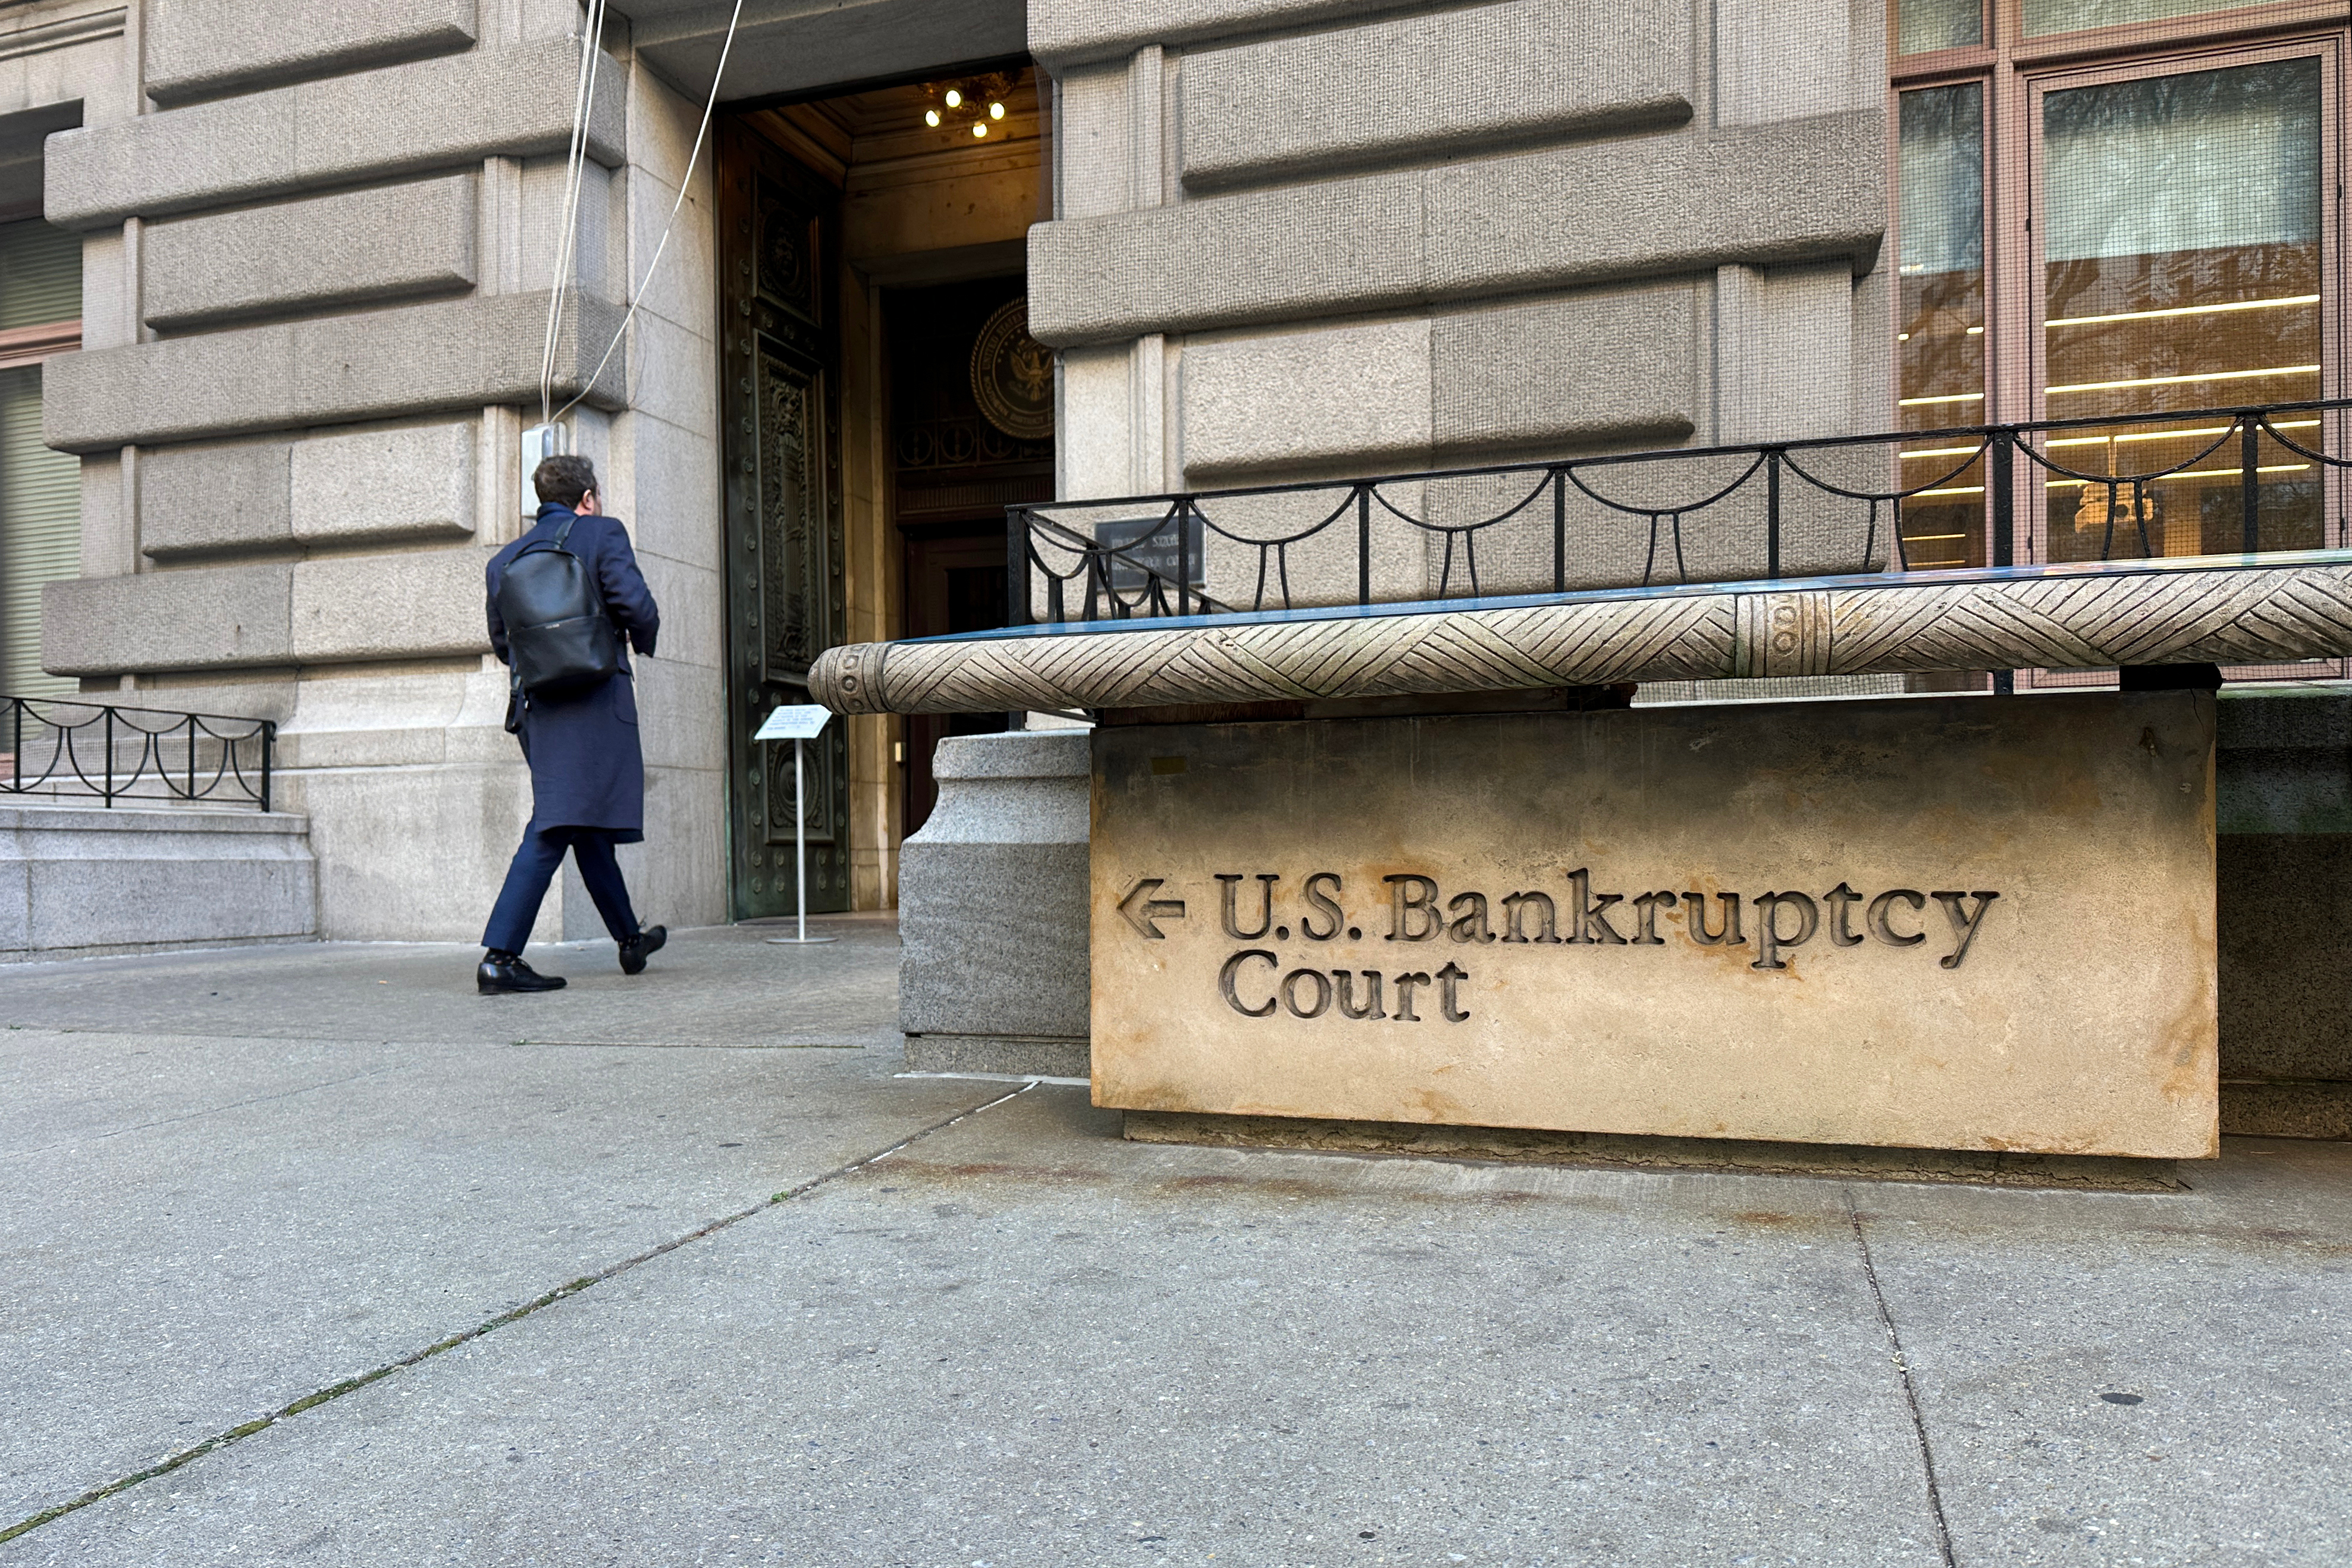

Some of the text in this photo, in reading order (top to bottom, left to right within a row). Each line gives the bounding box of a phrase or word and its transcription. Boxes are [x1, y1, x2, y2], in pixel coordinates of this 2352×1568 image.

[1213, 868, 2000, 968] U.S. Bankruptcy
[1218, 949, 1470, 1022] Court
